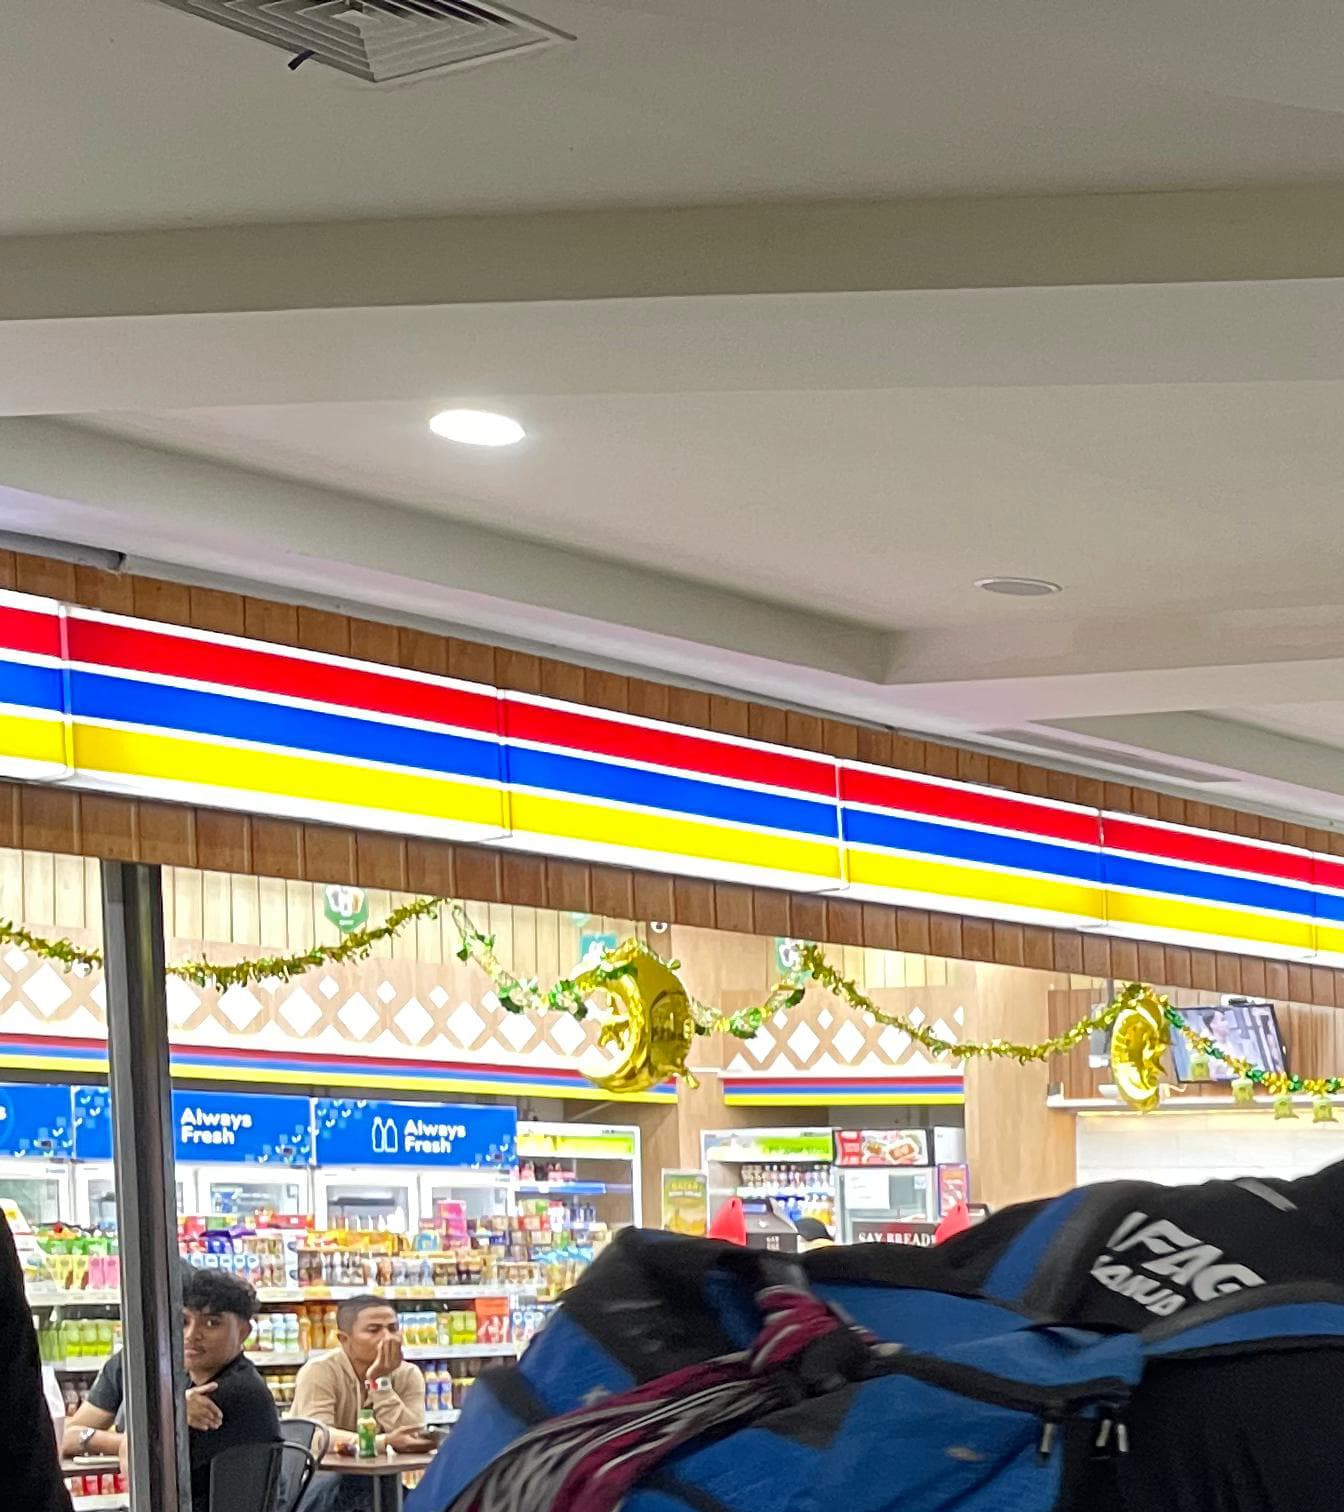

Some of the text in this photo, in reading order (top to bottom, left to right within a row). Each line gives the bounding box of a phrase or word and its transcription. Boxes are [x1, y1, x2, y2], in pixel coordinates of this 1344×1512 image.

[180, 1107, 253, 1131] Always
[403, 1118, 467, 1139] Always
[181, 1125, 235, 1145] Fresh
[404, 1138, 453, 1154] Fresh
